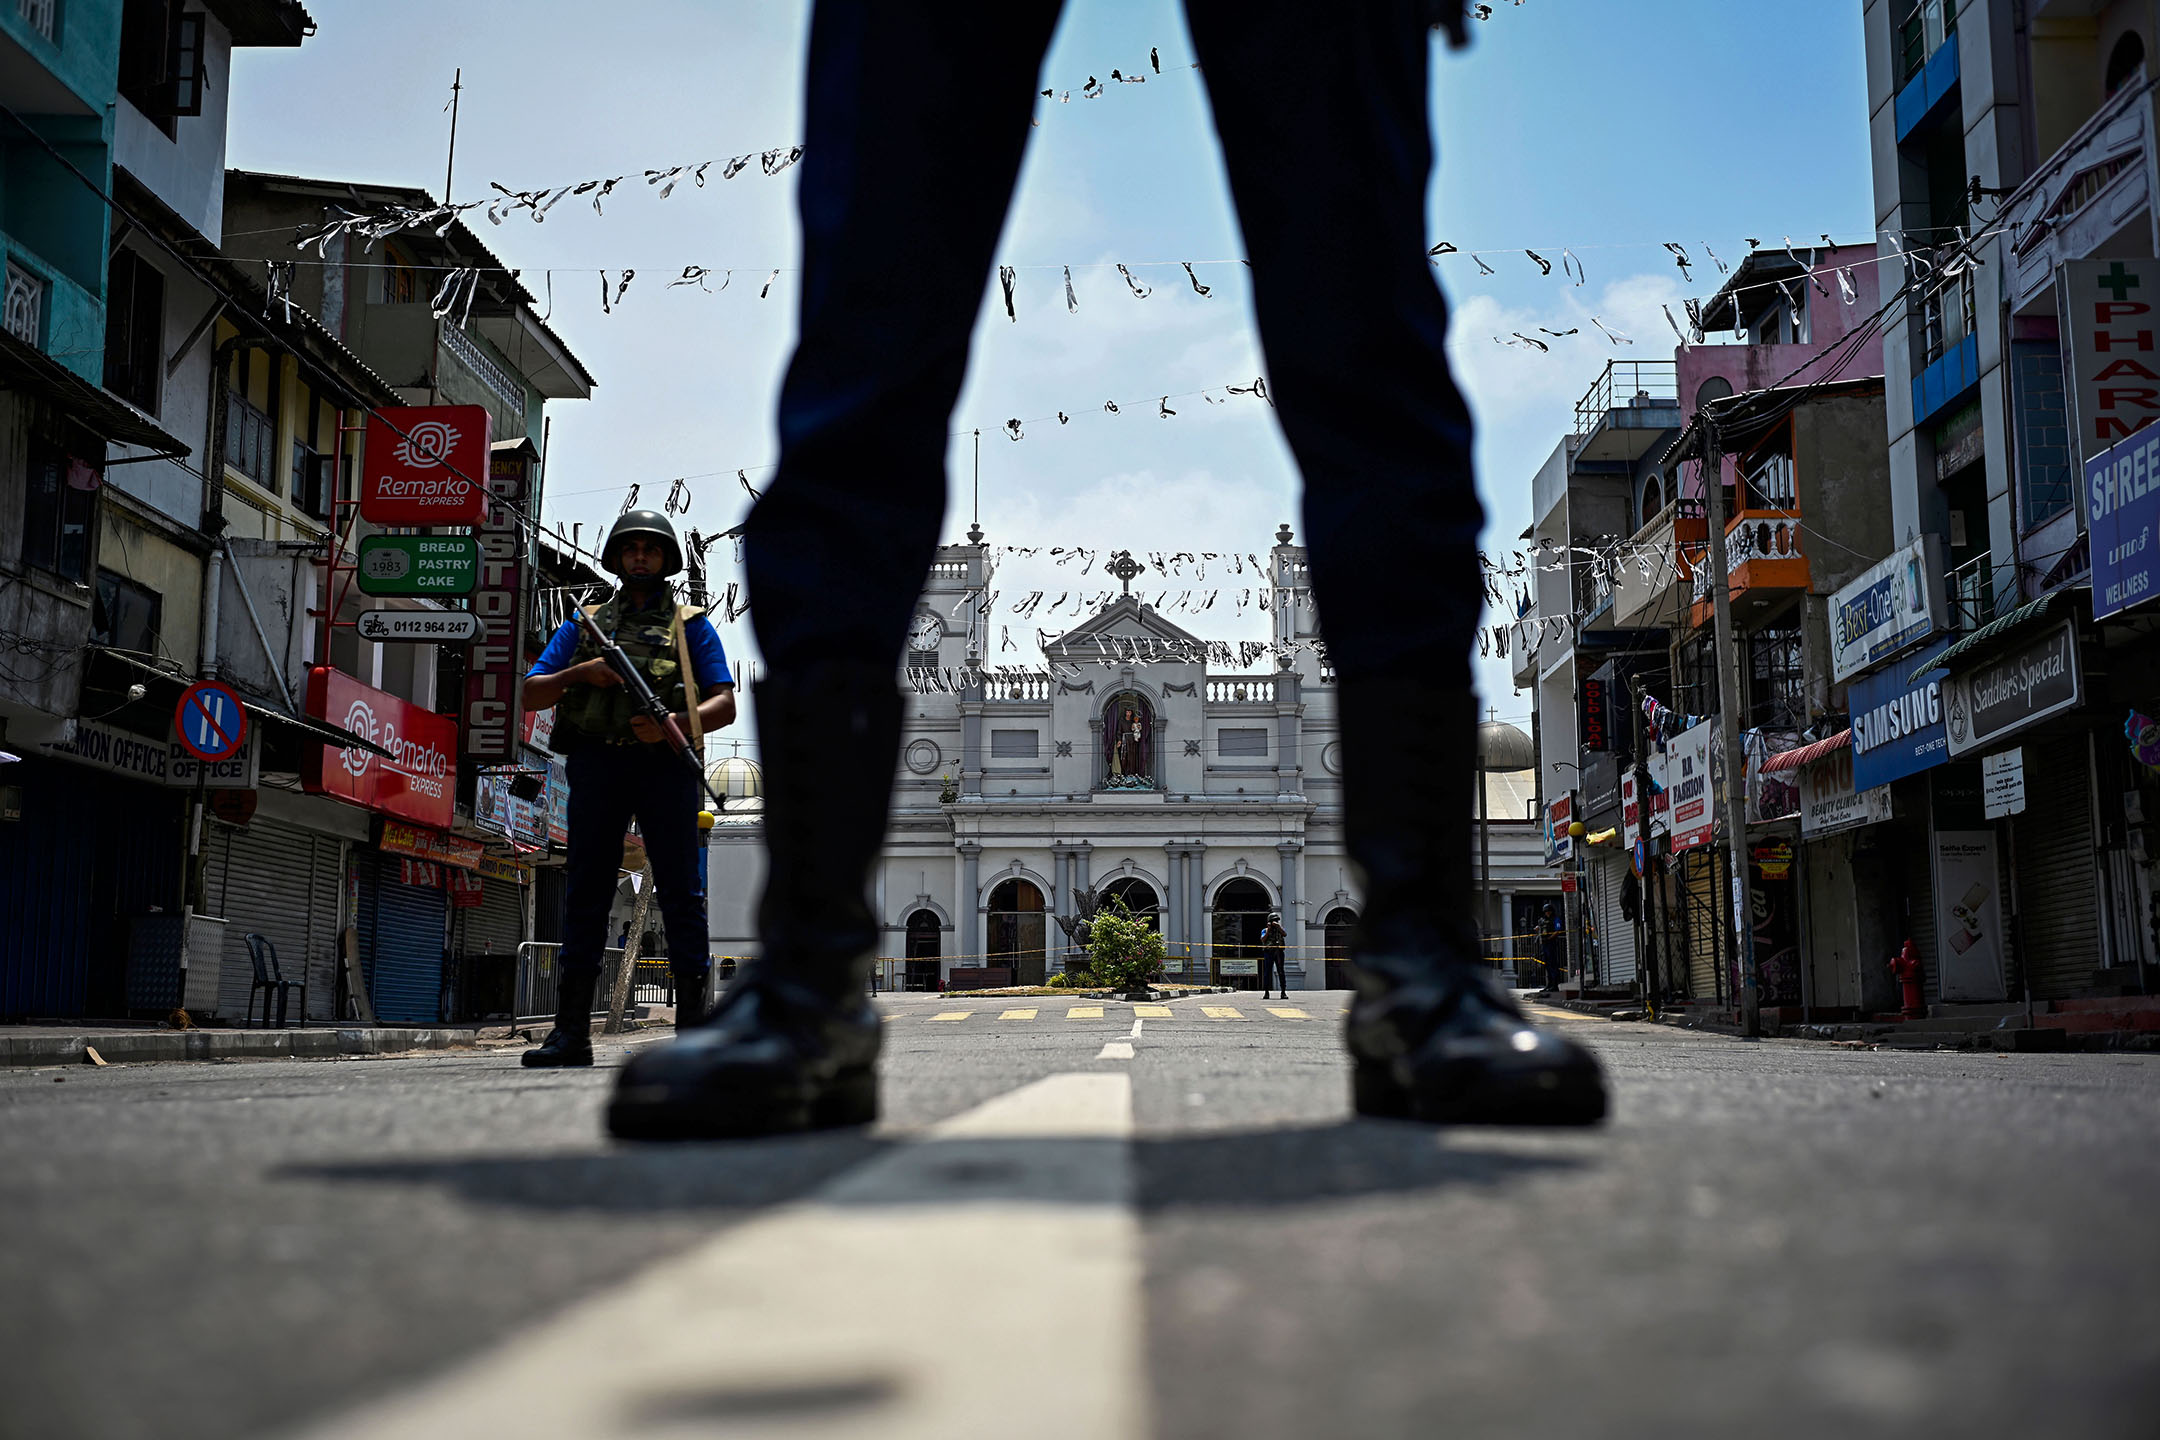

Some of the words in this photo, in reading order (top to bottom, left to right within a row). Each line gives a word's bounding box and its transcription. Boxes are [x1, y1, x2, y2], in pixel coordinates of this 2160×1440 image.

[377, 476, 470, 495] Remarko
[418, 496, 465, 506] EXPRESS
[418, 543, 466, 553] BREAD
[372, 561, 401, 572] 1983
[418, 560, 471, 569] PASTRY
[417, 577, 455, 586] CAKE
[2105, 570, 2149, 606] WELLNESS
[394, 622, 421, 632] 0112
[424, 622, 445, 632] 964
[447, 622, 469, 633] 247
[1974, 671, 2018, 714] Saddler's
[2020, 636, 2065, 708] Special
[1853, 682, 1941, 755] SAMSUNG
[114, 738, 166, 778] OFFICE
[383, 723, 447, 779] Remarko
[173, 762, 243, 778] OFFICE
[410, 775, 443, 799] EXPRESS
[1811, 799, 1834, 818] BEAUTY
[1836, 794, 1857, 811] CLINIC
[383, 823, 397, 844] Net
[398, 827, 414, 847] Cafe
